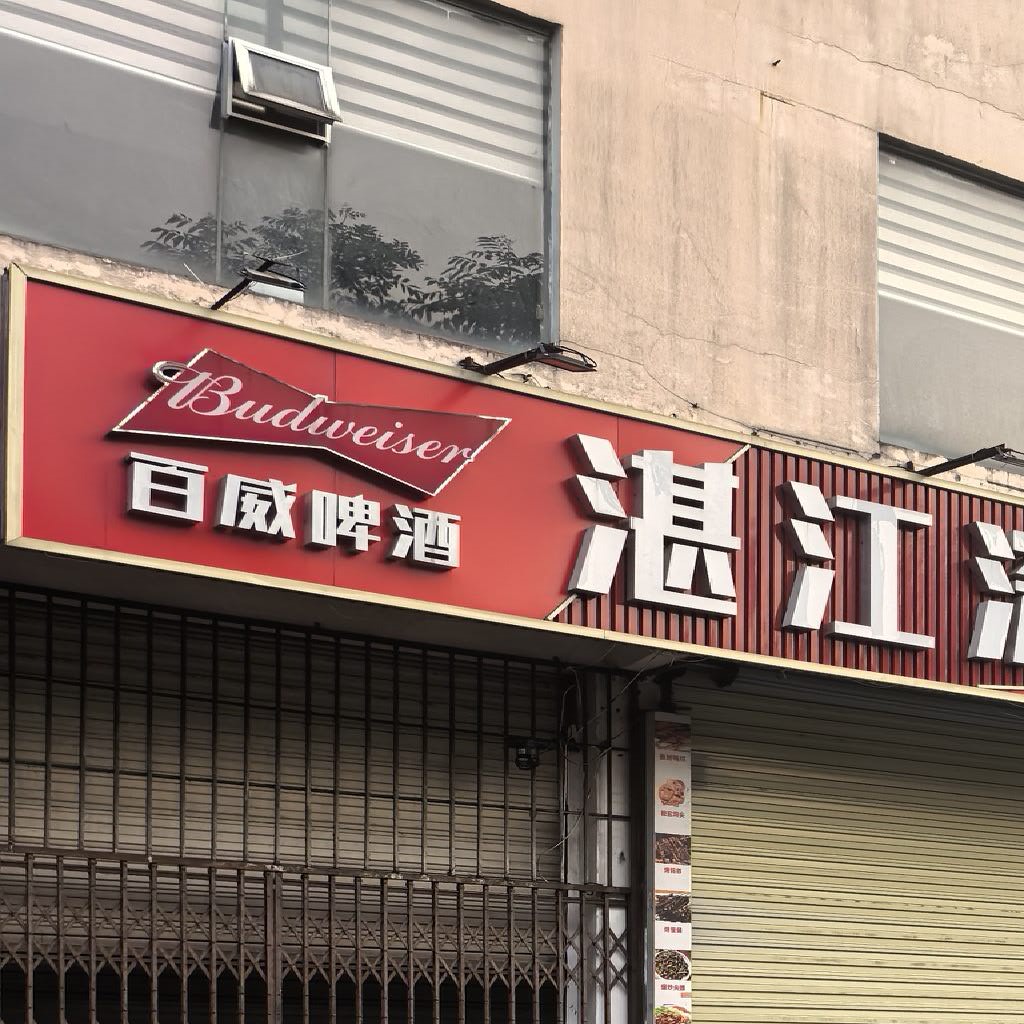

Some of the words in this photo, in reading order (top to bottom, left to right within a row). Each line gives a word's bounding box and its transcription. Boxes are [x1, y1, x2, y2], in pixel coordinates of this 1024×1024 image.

[152, 360, 475, 464] Budweiser
[127, 451, 462, 570] 百威啤酒
